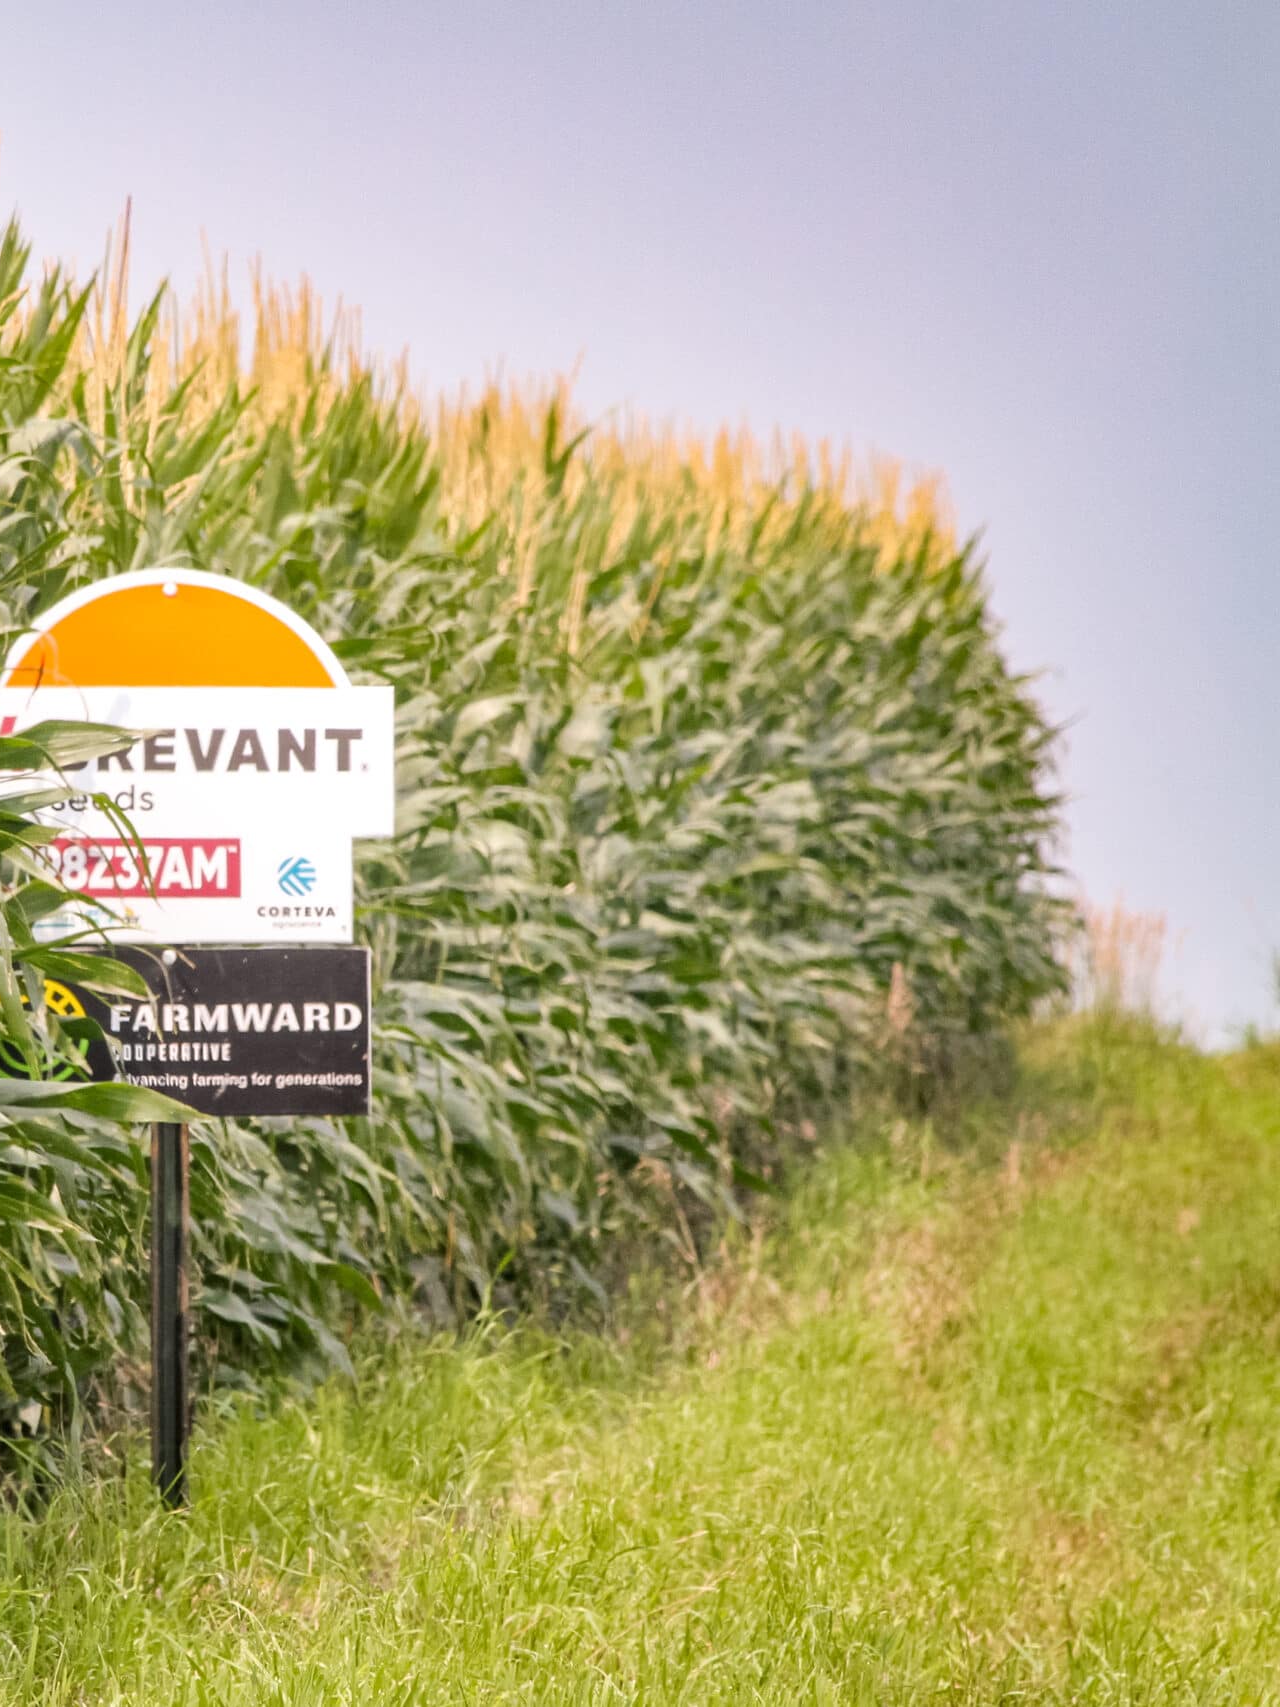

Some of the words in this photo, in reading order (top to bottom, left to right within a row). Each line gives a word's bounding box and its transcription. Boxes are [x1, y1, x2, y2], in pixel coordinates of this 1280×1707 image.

[61, 728, 363, 772] REVANT
[257, 906, 336, 917] CORTEVA
[110, 1003, 362, 1032] FARMWARD
[192, 1073, 248, 1089] farming
[251, 1072, 272, 1085] for
[275, 1072, 363, 1089] generations
